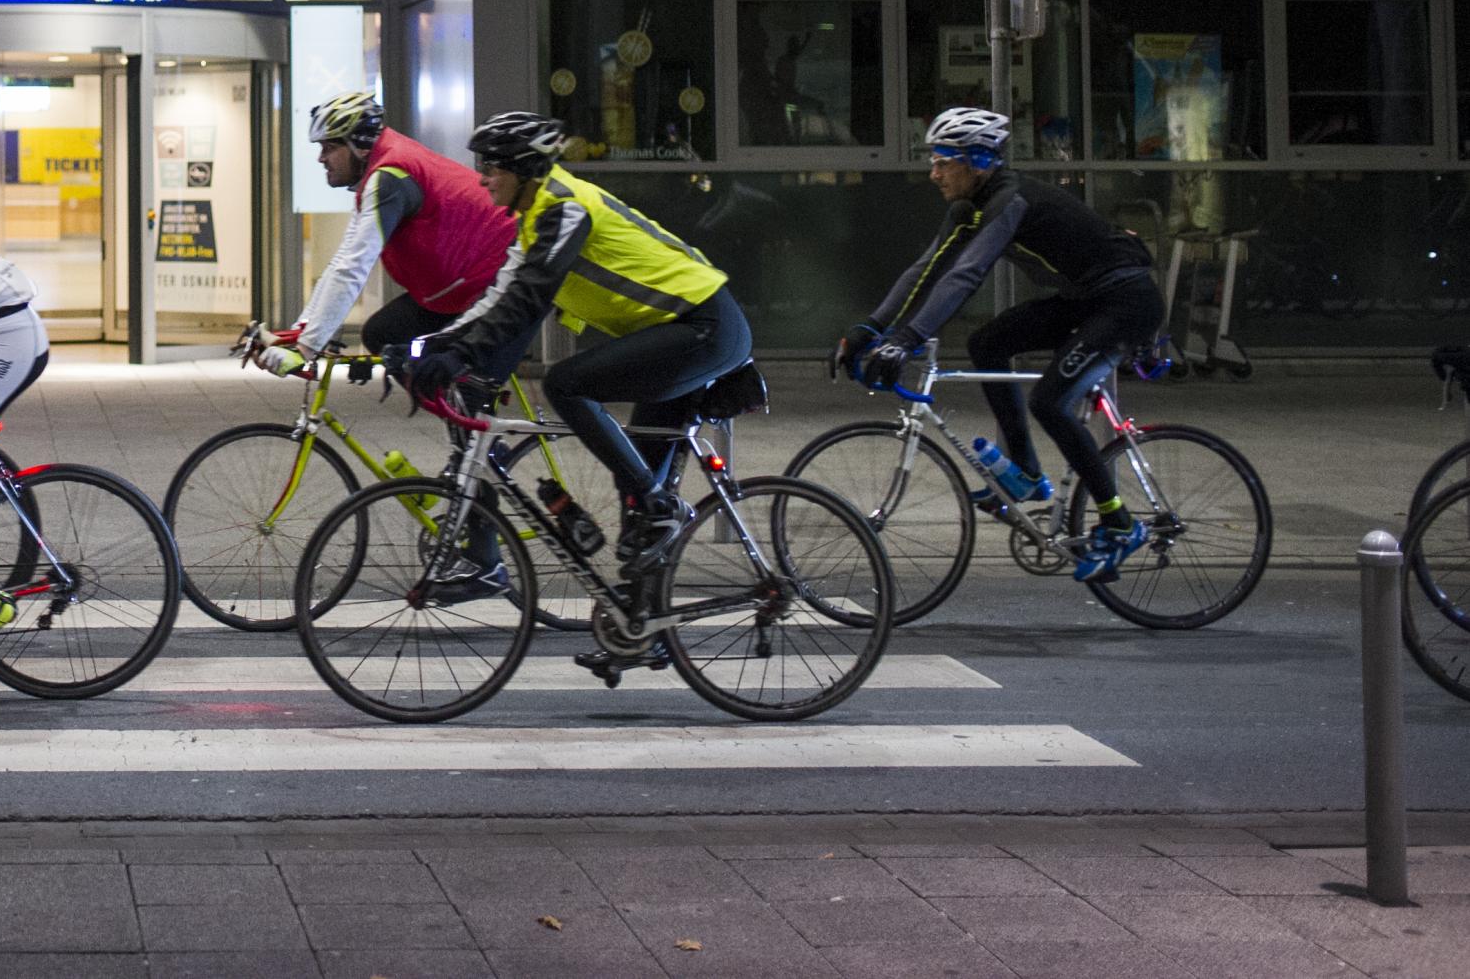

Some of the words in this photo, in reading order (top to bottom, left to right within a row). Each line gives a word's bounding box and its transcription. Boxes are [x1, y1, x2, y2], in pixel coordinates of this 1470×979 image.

[610, 146, 655, 159] Thomas
[657, 146, 690, 159] Cook
[496, 481, 614, 609] cannondale
